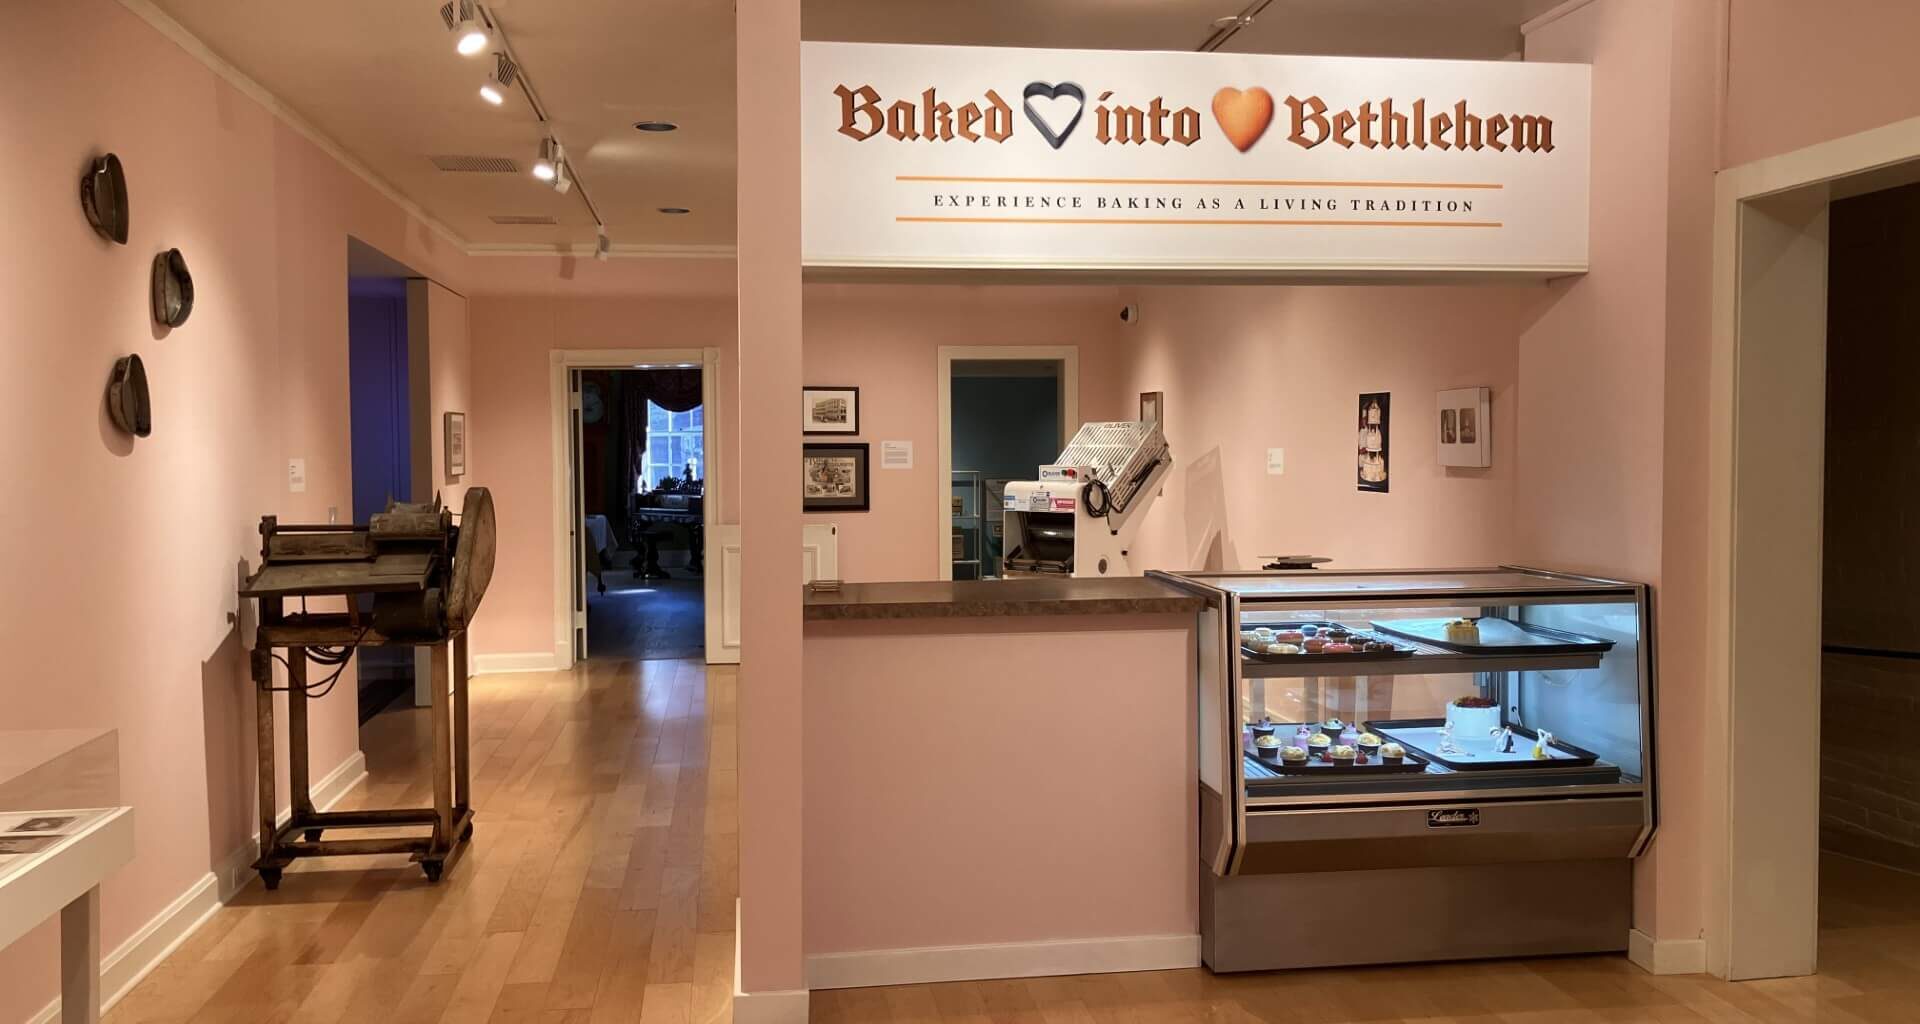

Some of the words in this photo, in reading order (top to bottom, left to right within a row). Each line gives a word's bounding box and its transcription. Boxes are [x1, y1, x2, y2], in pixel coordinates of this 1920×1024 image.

[833, 83, 1015, 143] Baked
[1094, 90, 1202, 147] into
[1283, 94, 1556, 154] Bethlehem
[933, 194, 1084, 210] EXPERIENCE
[1096, 196, 1184, 211] BAKING
[1196, 197, 1222, 211] AS
[1233, 197, 1247, 211] A
[1259, 198, 1339, 212] LIVING
[1350, 199, 1475, 213] TRADITION
